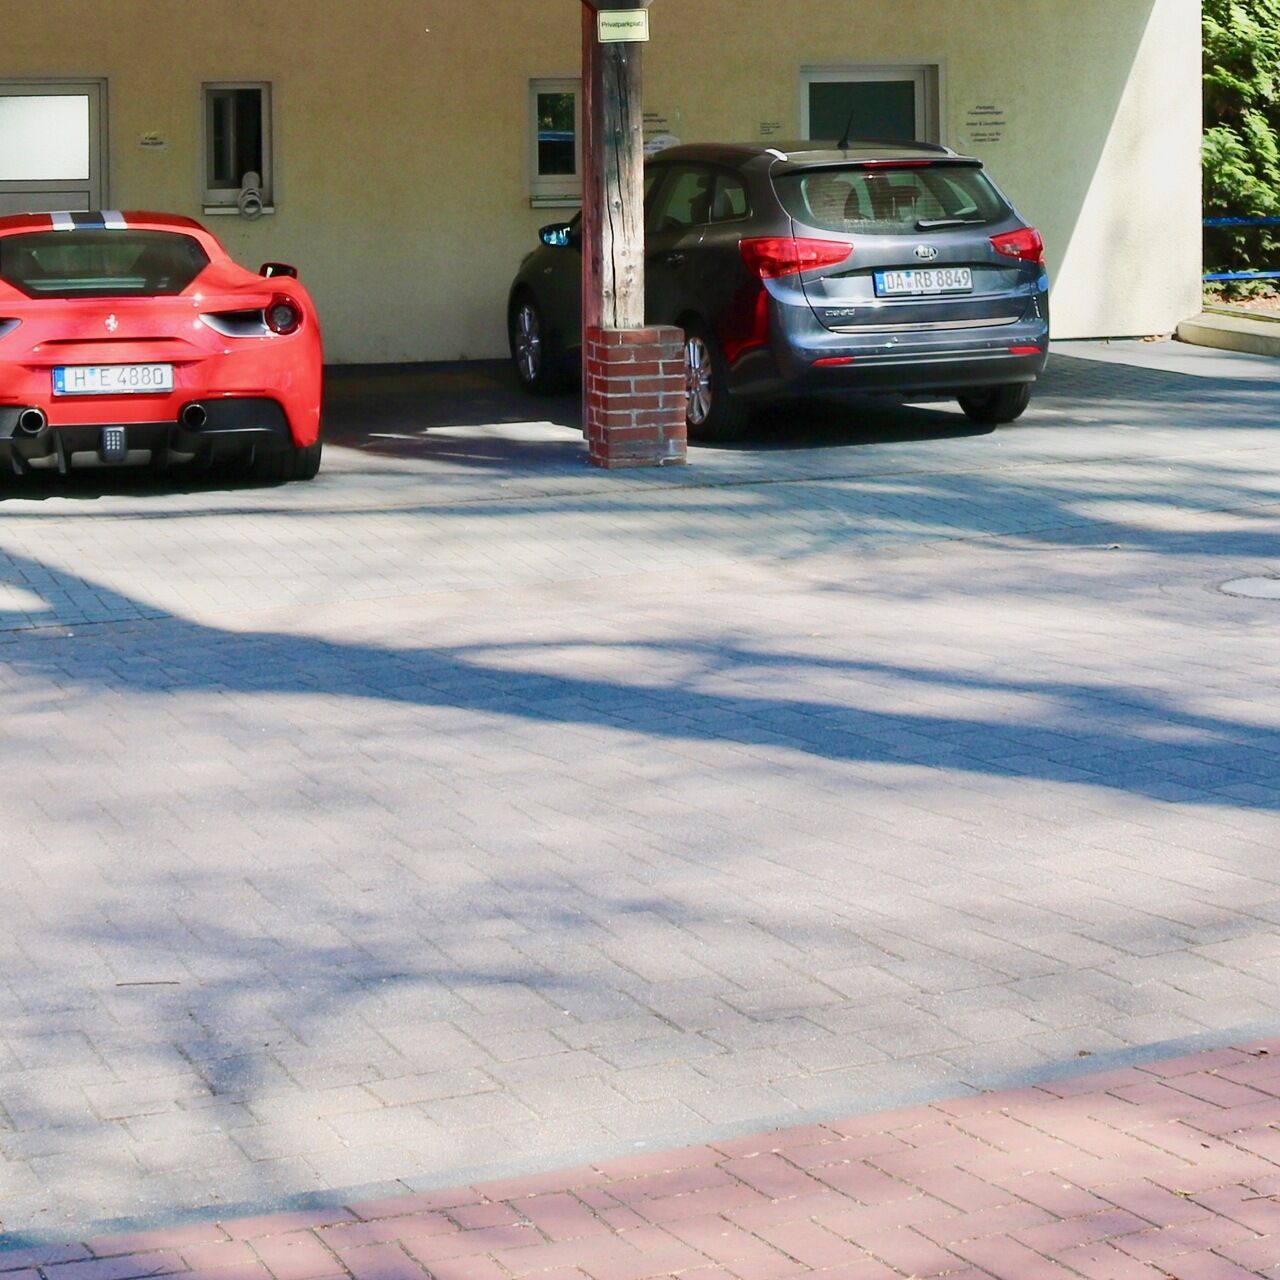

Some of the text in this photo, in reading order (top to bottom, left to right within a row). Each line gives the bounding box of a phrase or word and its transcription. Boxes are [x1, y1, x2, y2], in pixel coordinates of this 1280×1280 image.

[601, 21, 644, 29] Privatparkplatz
[886, 269, 970, 290] DA RB 8849
[74, 367, 164, 387] H E 4880
